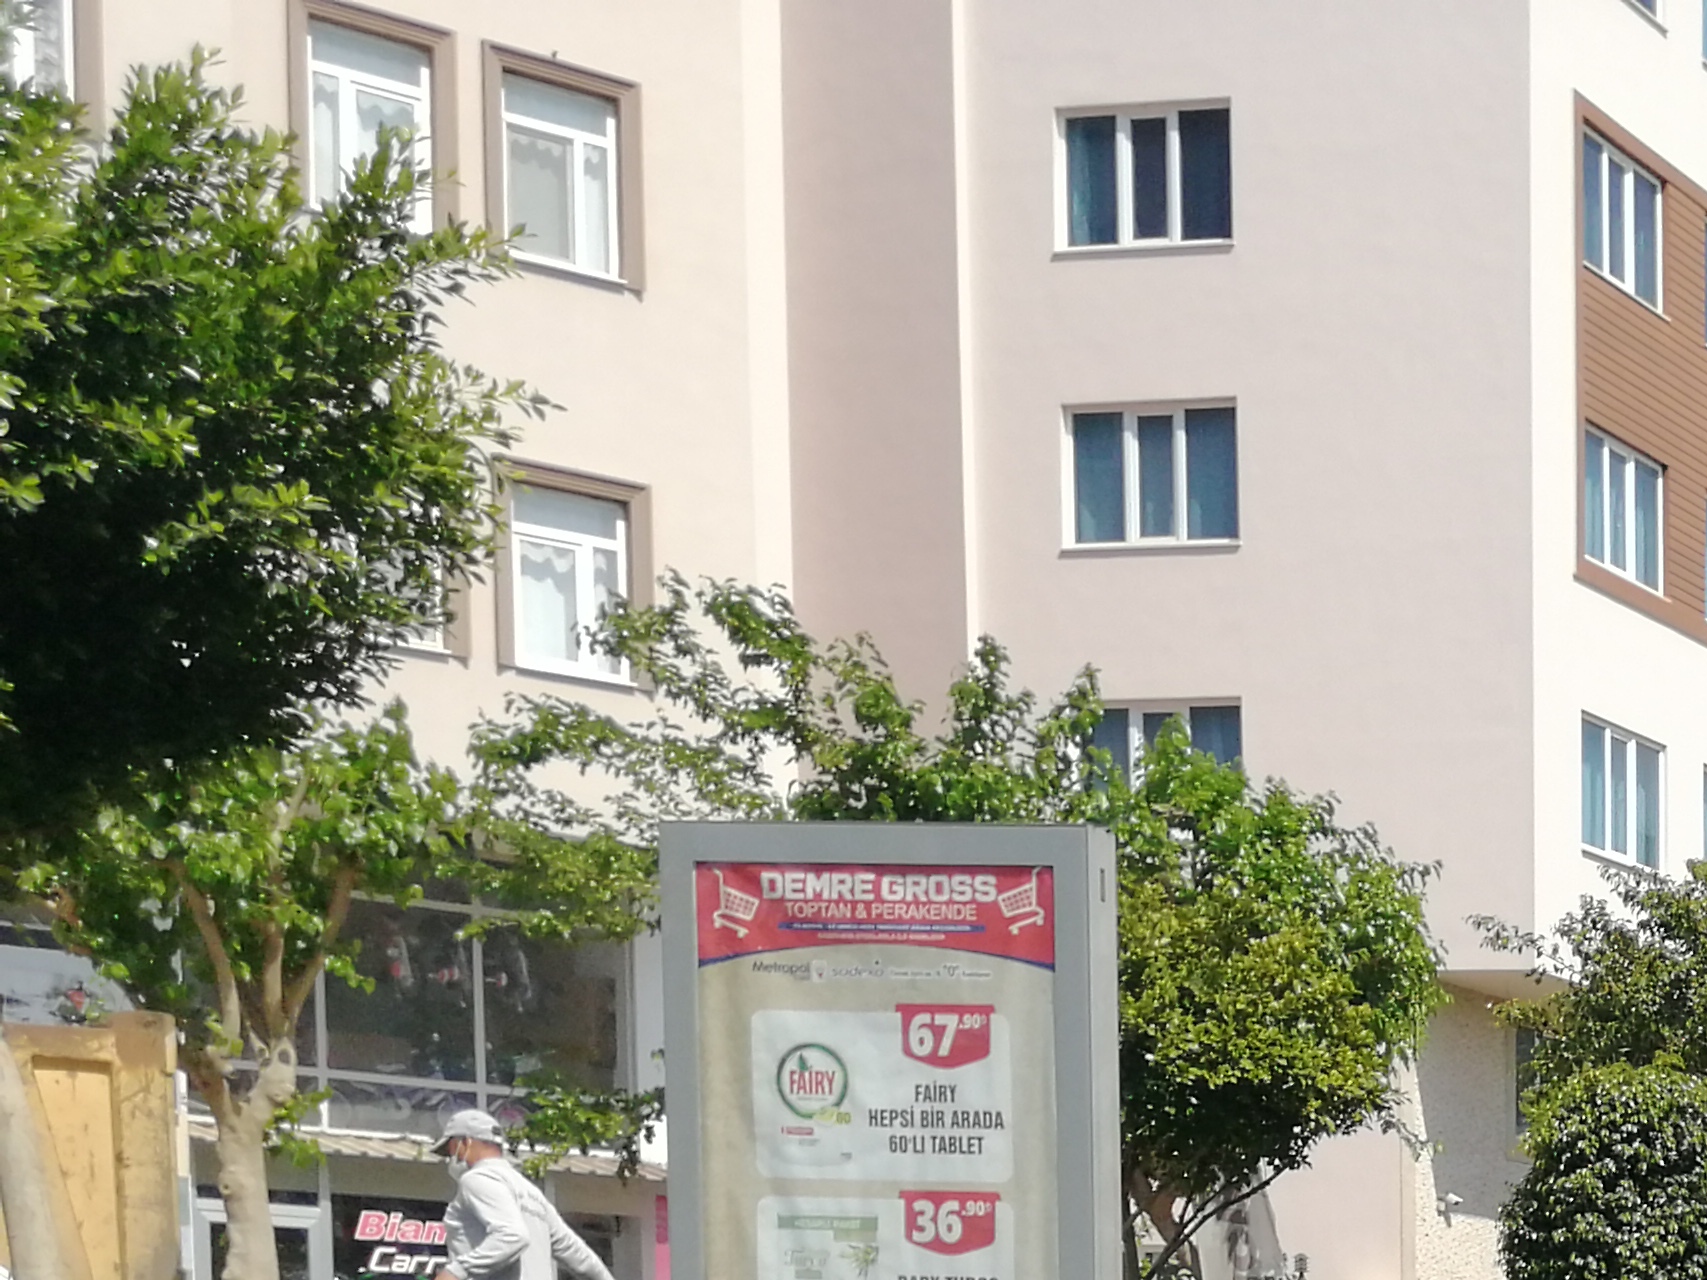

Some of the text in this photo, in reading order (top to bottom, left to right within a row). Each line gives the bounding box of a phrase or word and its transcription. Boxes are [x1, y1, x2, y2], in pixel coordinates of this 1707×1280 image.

[760, 872, 998, 902] DEMRE GROSS
[785, 902, 977, 920] TOPTAN & PERAKENDE
[914, 1080, 957, 1103] FAİRY
[868, 1105, 1006, 1130] HEPSİ BİR ARADA
[930, 1136, 985, 1156] TABLET
[354, 1209, 448, 1245] Bian
[369, 1245, 448, 1275] Carr
